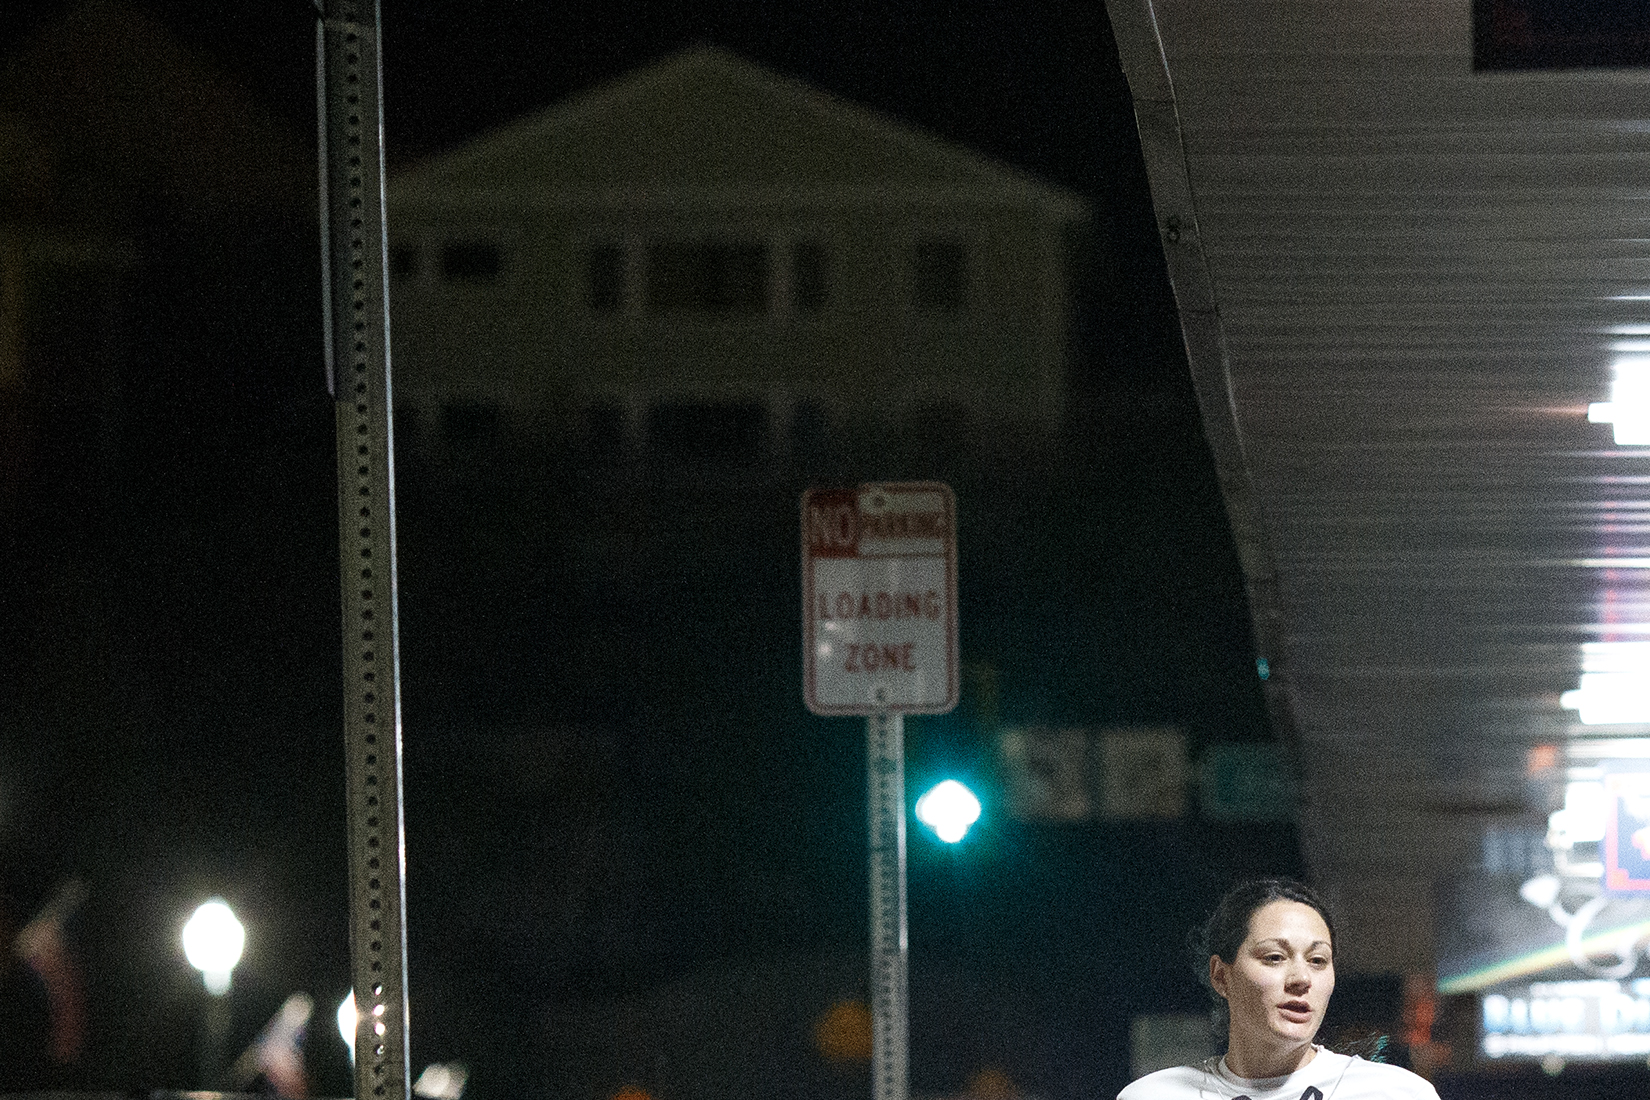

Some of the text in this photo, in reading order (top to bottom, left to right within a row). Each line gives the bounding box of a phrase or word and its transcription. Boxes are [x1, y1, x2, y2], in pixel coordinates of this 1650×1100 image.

[808, 503, 858, 548] NO
[818, 591, 940, 622] LOADING
[845, 642, 916, 674] ZONE
